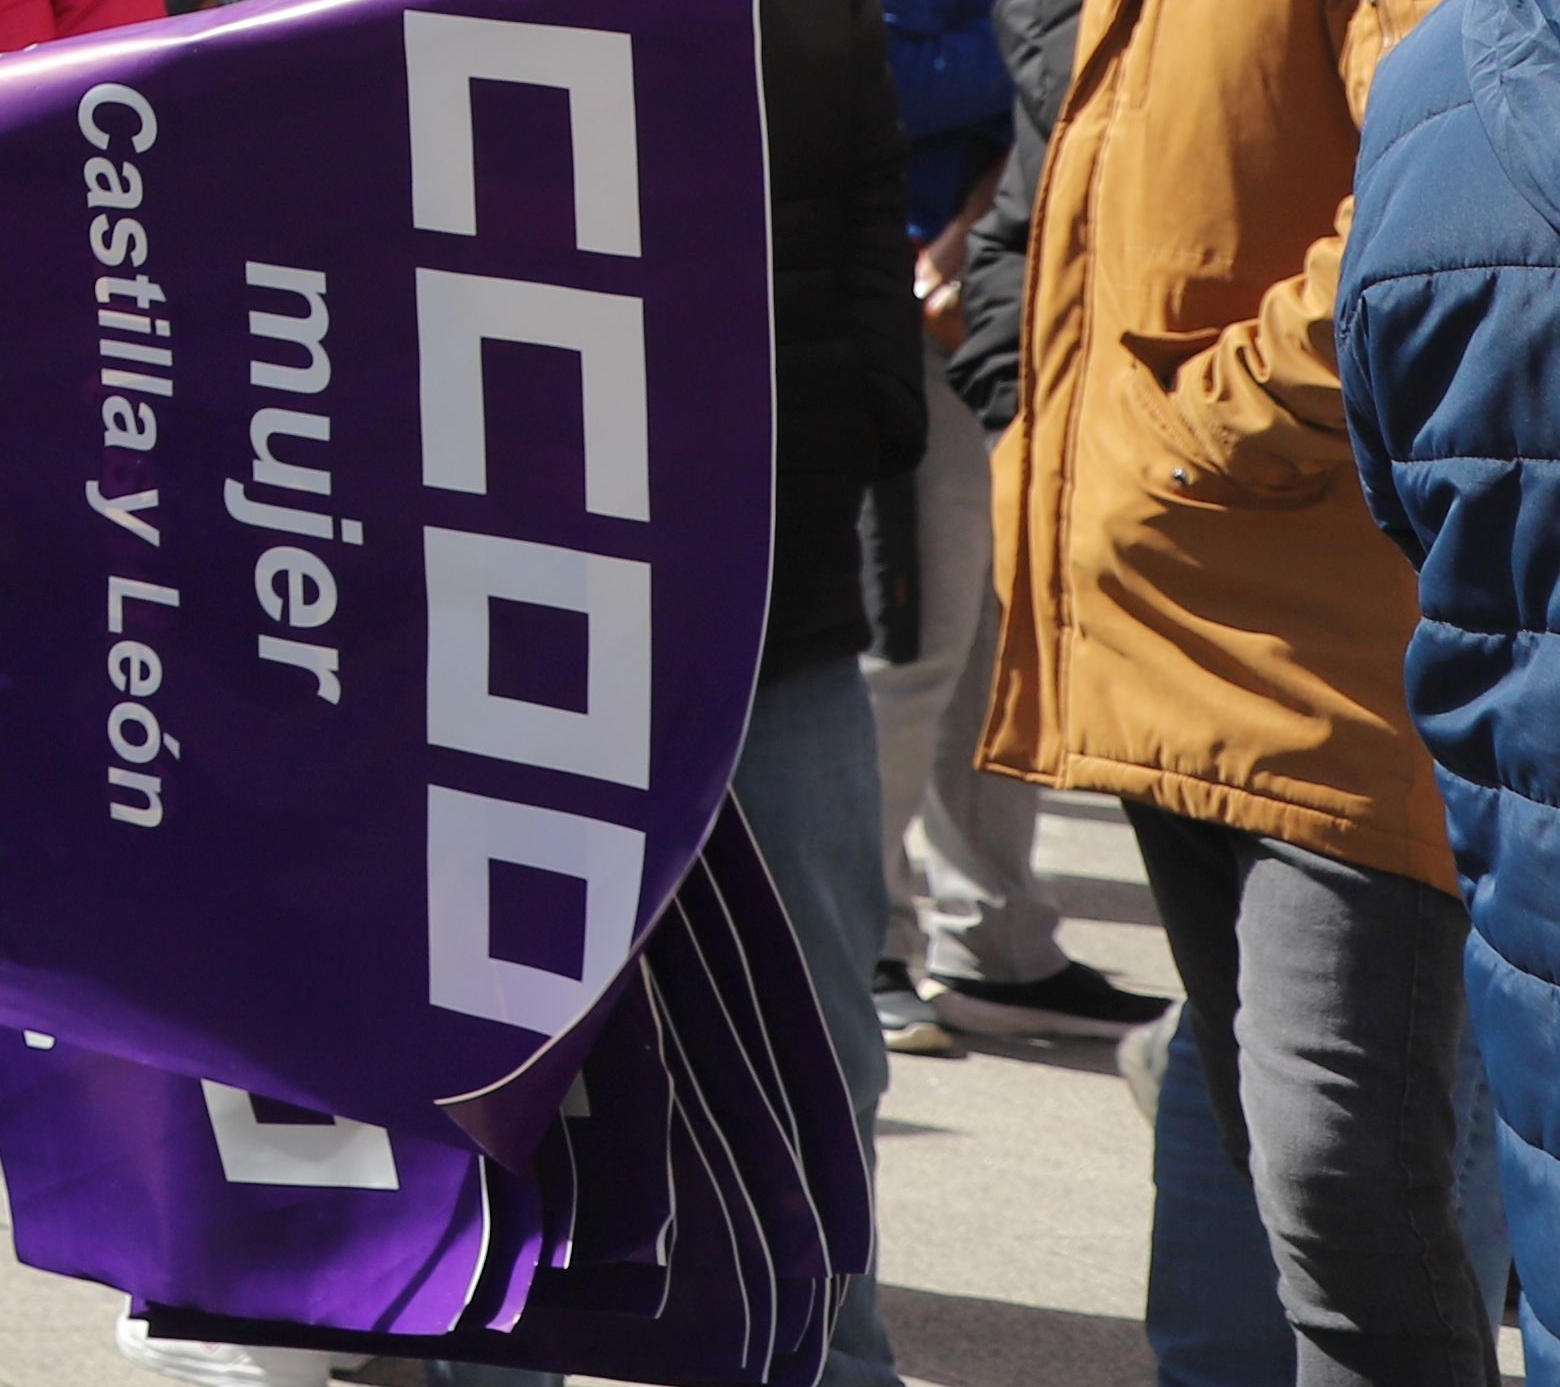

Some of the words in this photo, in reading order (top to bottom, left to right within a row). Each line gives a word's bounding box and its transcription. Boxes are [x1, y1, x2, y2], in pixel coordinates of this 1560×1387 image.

[77, 81, 175, 453] Castilla
[85, 480, 163, 547] y
[224, 259, 364, 704] mujer
[403, 9, 652, 1039] CCOO
[105, 574, 184, 831] León
